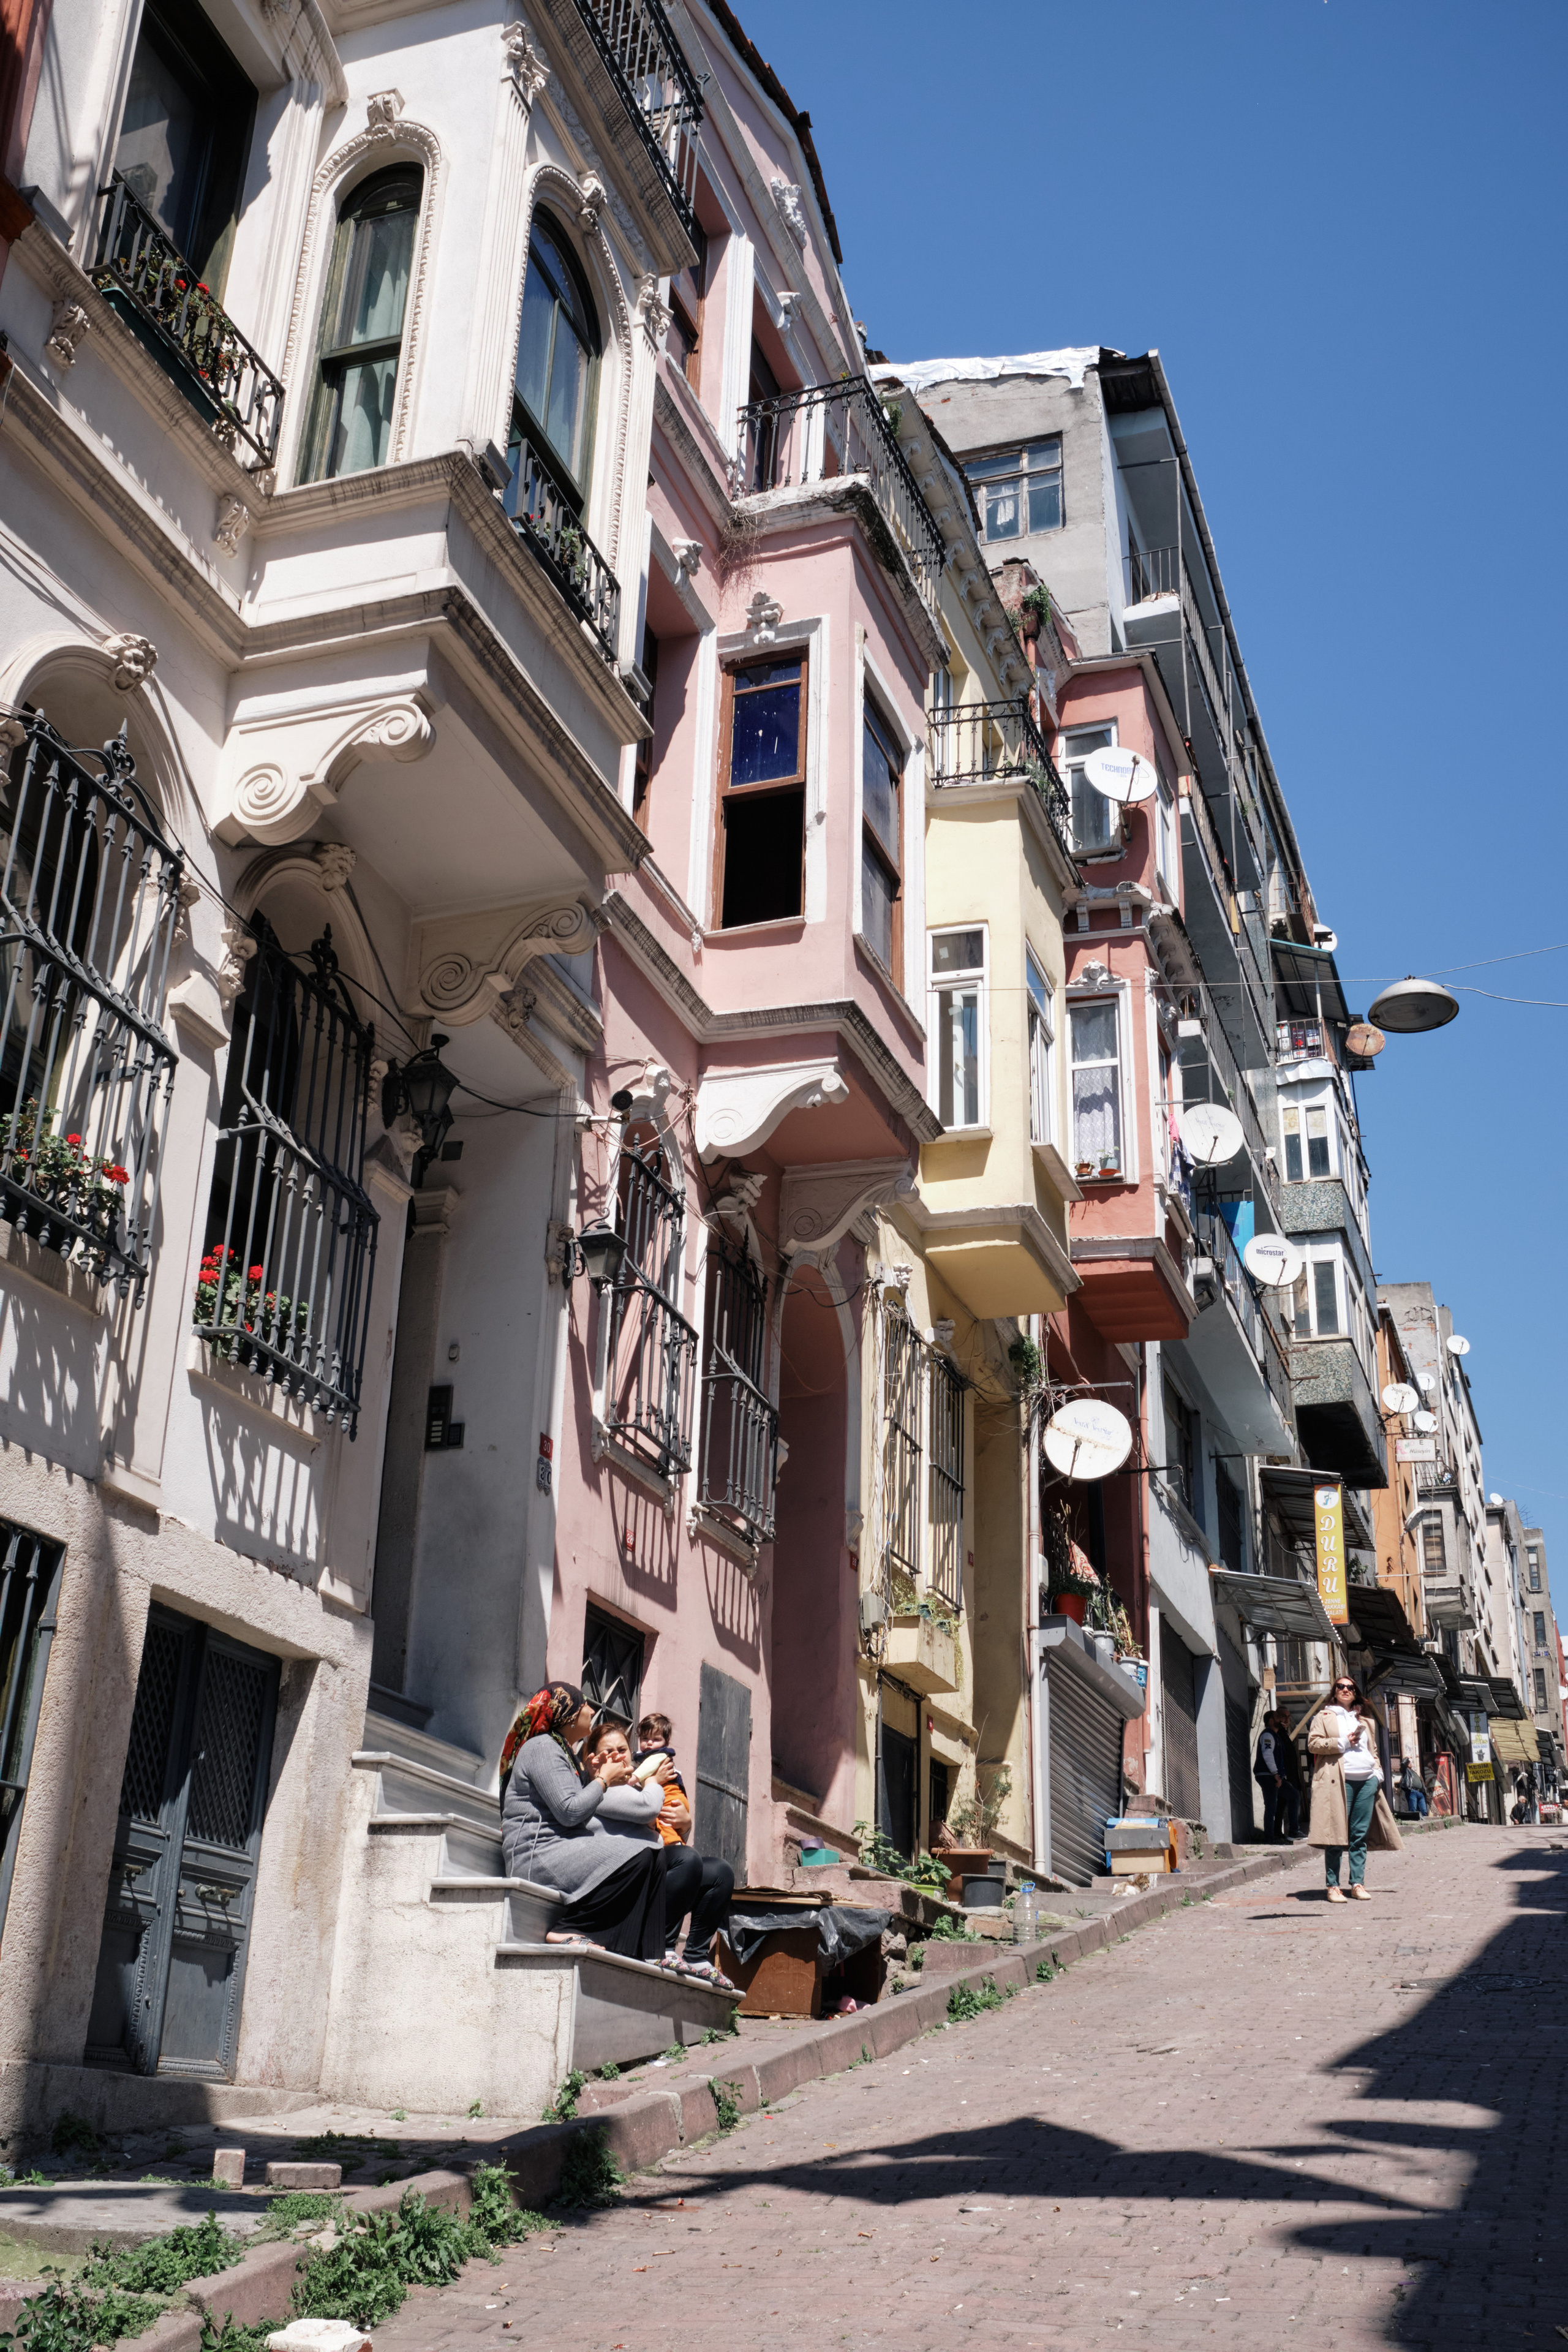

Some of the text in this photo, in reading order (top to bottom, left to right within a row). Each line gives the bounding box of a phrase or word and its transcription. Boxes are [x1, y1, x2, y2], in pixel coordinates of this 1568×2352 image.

[1256, 1247, 1284, 1256] microstar
[543, 1440, 551, 1453] 30
[540, 1466, 551, 1484] 30
[1320, 1515, 1339, 1593] DURU
